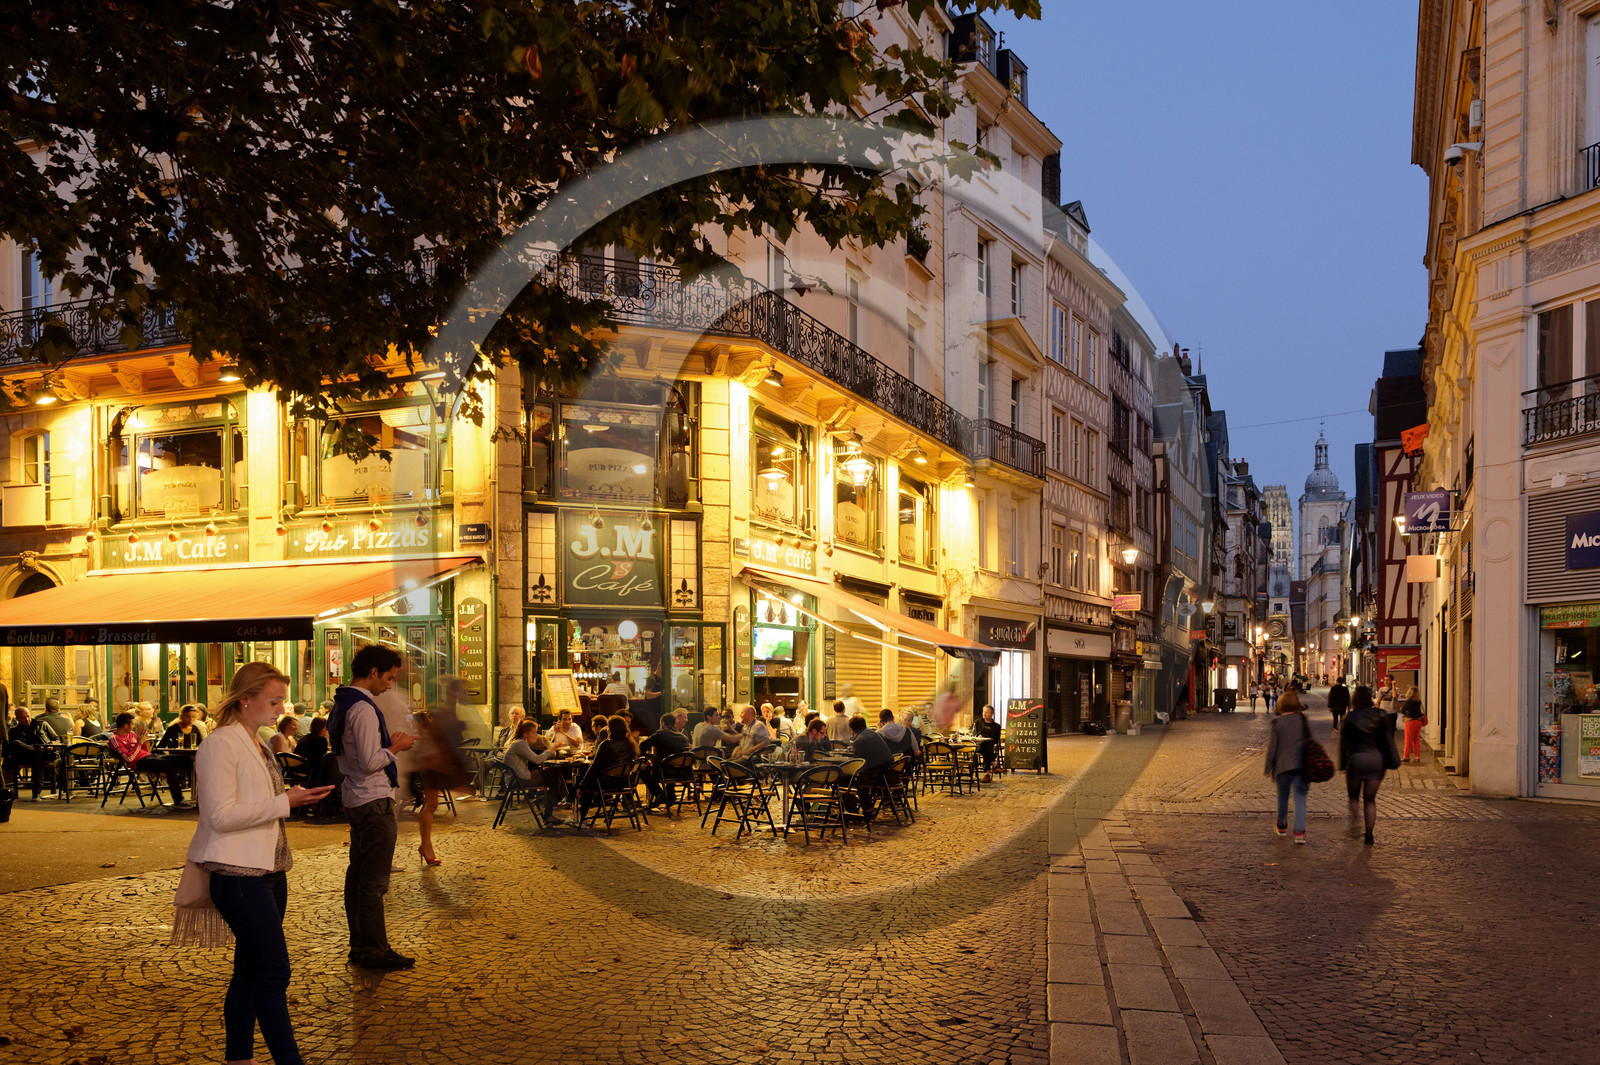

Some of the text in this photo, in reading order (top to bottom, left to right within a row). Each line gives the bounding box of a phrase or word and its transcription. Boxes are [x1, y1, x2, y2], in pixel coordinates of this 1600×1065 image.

[588, 463, 606, 471] PUB
[304, 527, 429, 553] Pub Pizzas
[177, 535, 227, 559] Café
[785, 547, 812, 570] Café
[573, 564, 654, 597] Café
[1541, 611, 1597, 621] SMARTPHONES
[65, 629, 87, 643] Pub
[98, 628, 157, 643] Brasserie
[267, 626, 283, 635] BAR
[990, 626, 1022, 642] swatch
[460, 632, 482, 642] GRILL
[461, 645, 482, 655] PIZZAS
[460, 658, 483, 667] SALADES
[1009, 728, 1038, 736] PIZZAS
[1008, 736, 1039, 744] SALADES
